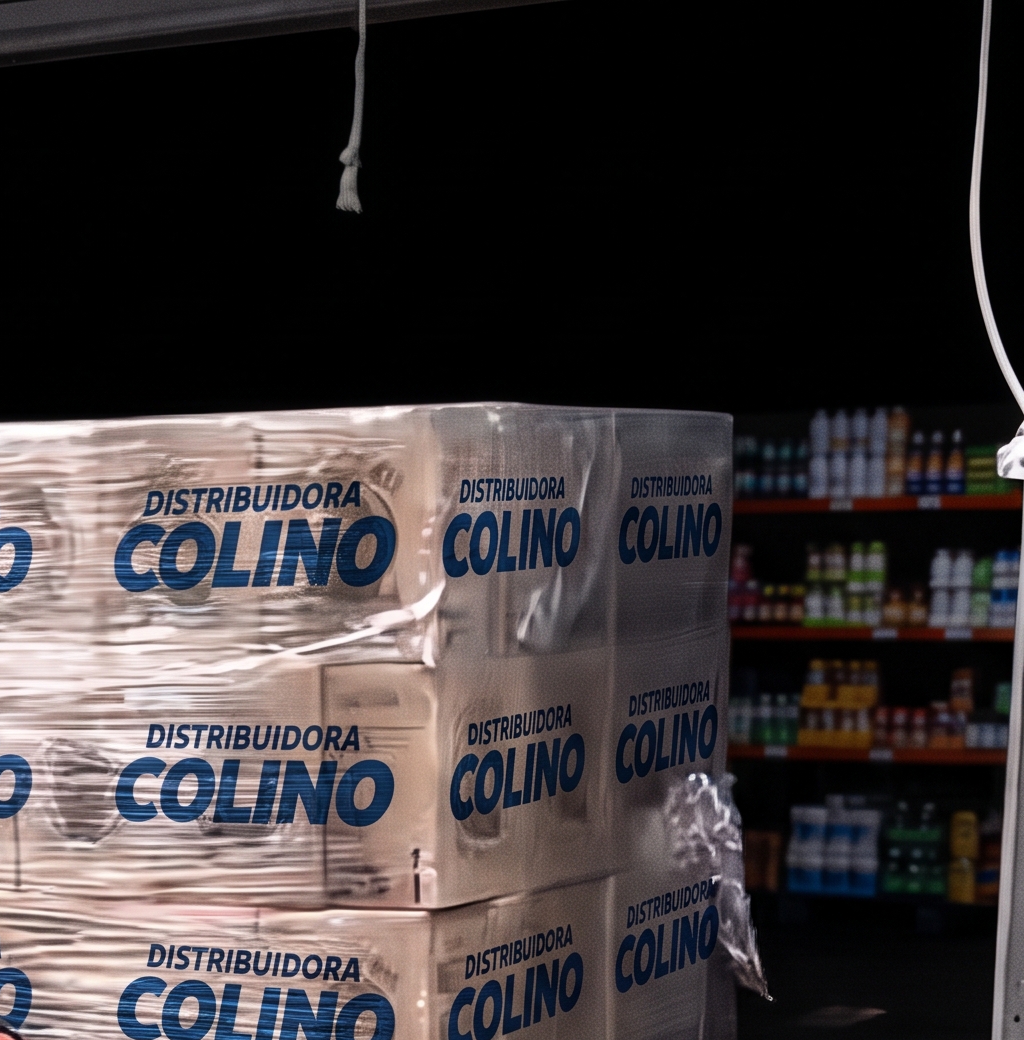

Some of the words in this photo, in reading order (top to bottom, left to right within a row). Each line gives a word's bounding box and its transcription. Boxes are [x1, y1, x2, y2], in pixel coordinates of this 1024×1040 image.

[143, 481, 361, 518] DISTRIBUIDORA
[459, 476, 565, 504] DISTRIBUIDORA
[631, 474, 713, 499] DISTRIBUIDORA
[113, 515, 396, 593] COLINO
[441, 506, 581, 579] COLINO
[618, 503, 722, 565] COLINO
[467, 704, 572, 746] DISTRIBUIDORA
[628, 680, 710, 718] DISTRIBUIDORA
[145, 723, 360, 752] DISTRIBUIDORA
[615, 704, 718, 784] COLINO
[114, 755, 395, 828] COLINO
[450, 732, 586, 821] COLINO
[146, 943, 361, 983] DISTRIBUIDORA
[464, 923, 574, 980] DISTRIBUIDORA
[615, 904, 720, 994] COLINO
